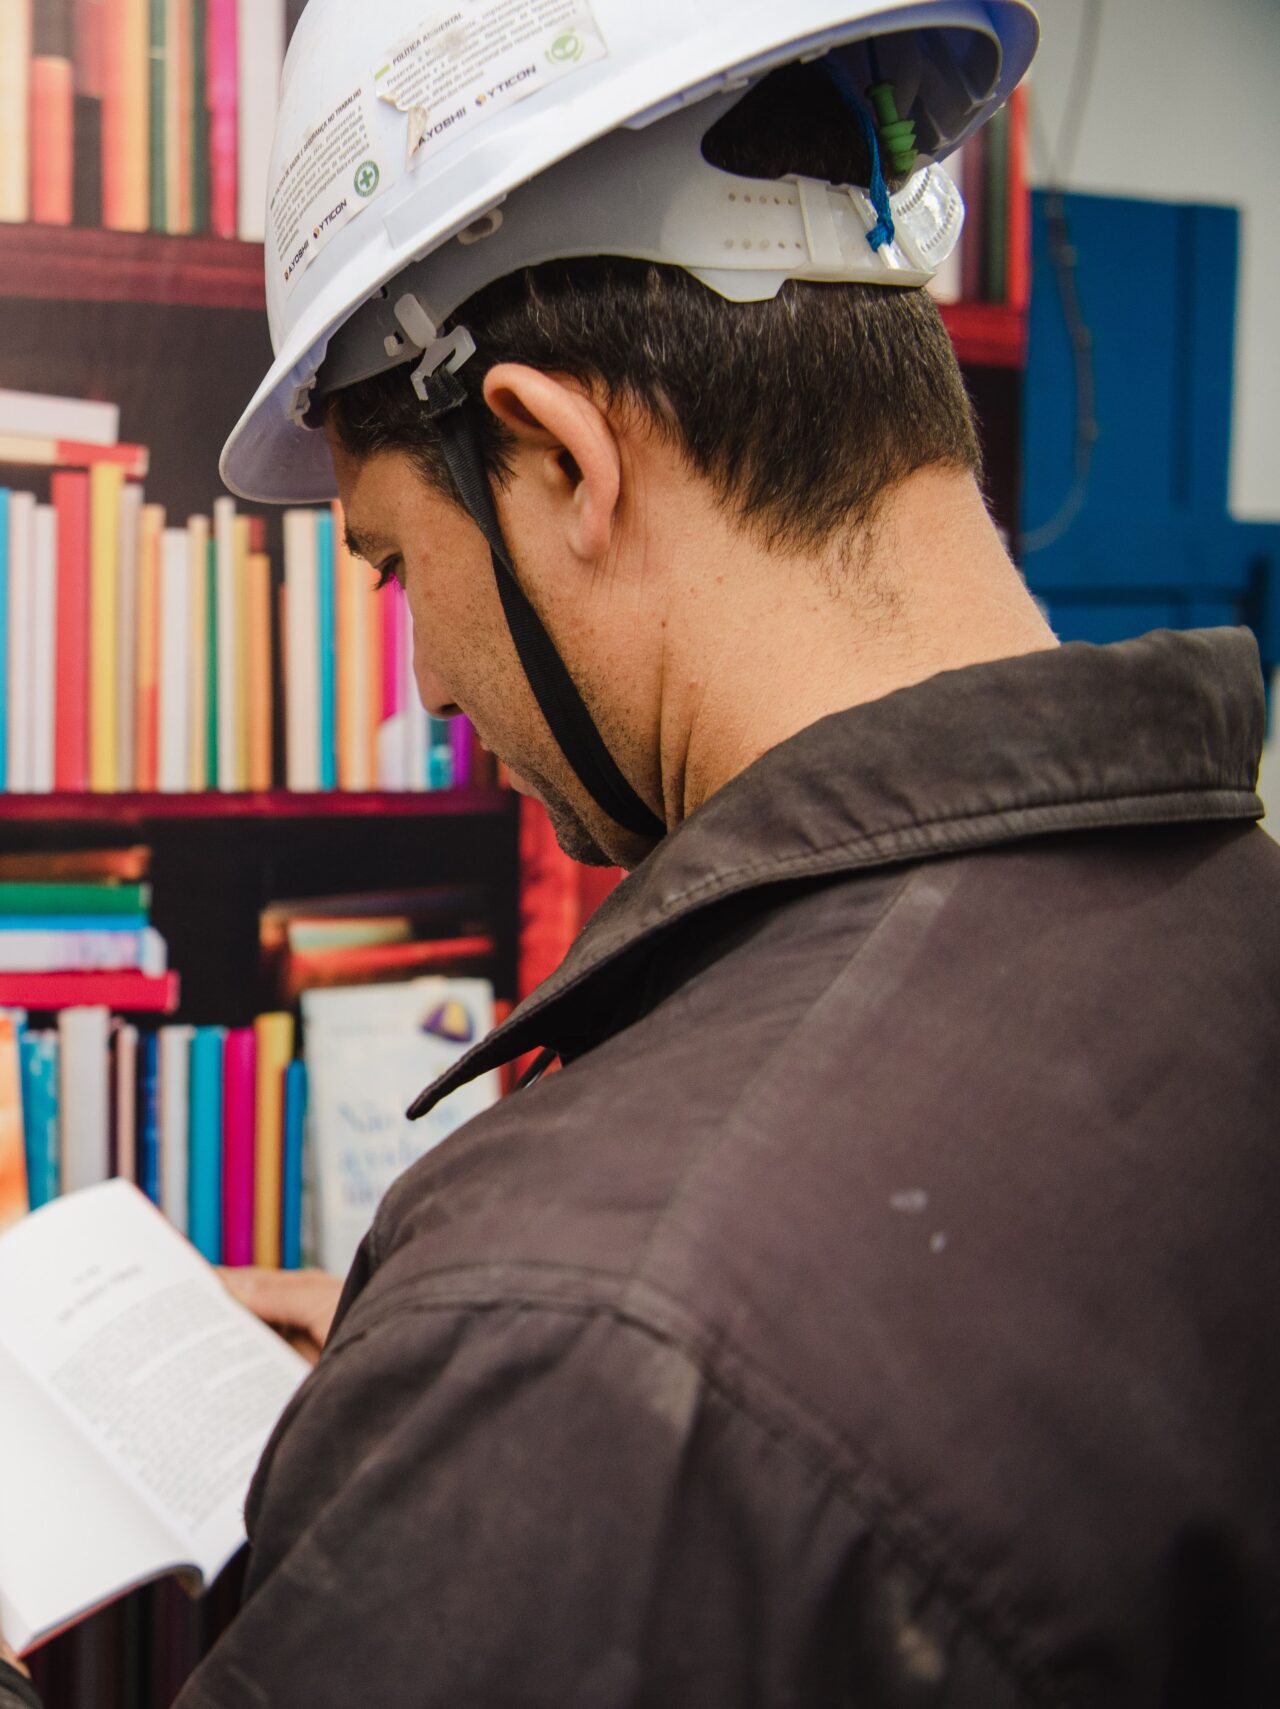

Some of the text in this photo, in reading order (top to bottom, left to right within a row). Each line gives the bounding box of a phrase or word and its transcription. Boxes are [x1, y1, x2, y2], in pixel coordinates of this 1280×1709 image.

[486, 63, 537, 98] YTICON
[417, 106, 467, 148] A.YOSHII
[318, 198, 348, 231] YTICON
[287, 239, 310, 275] A.YOSHII
